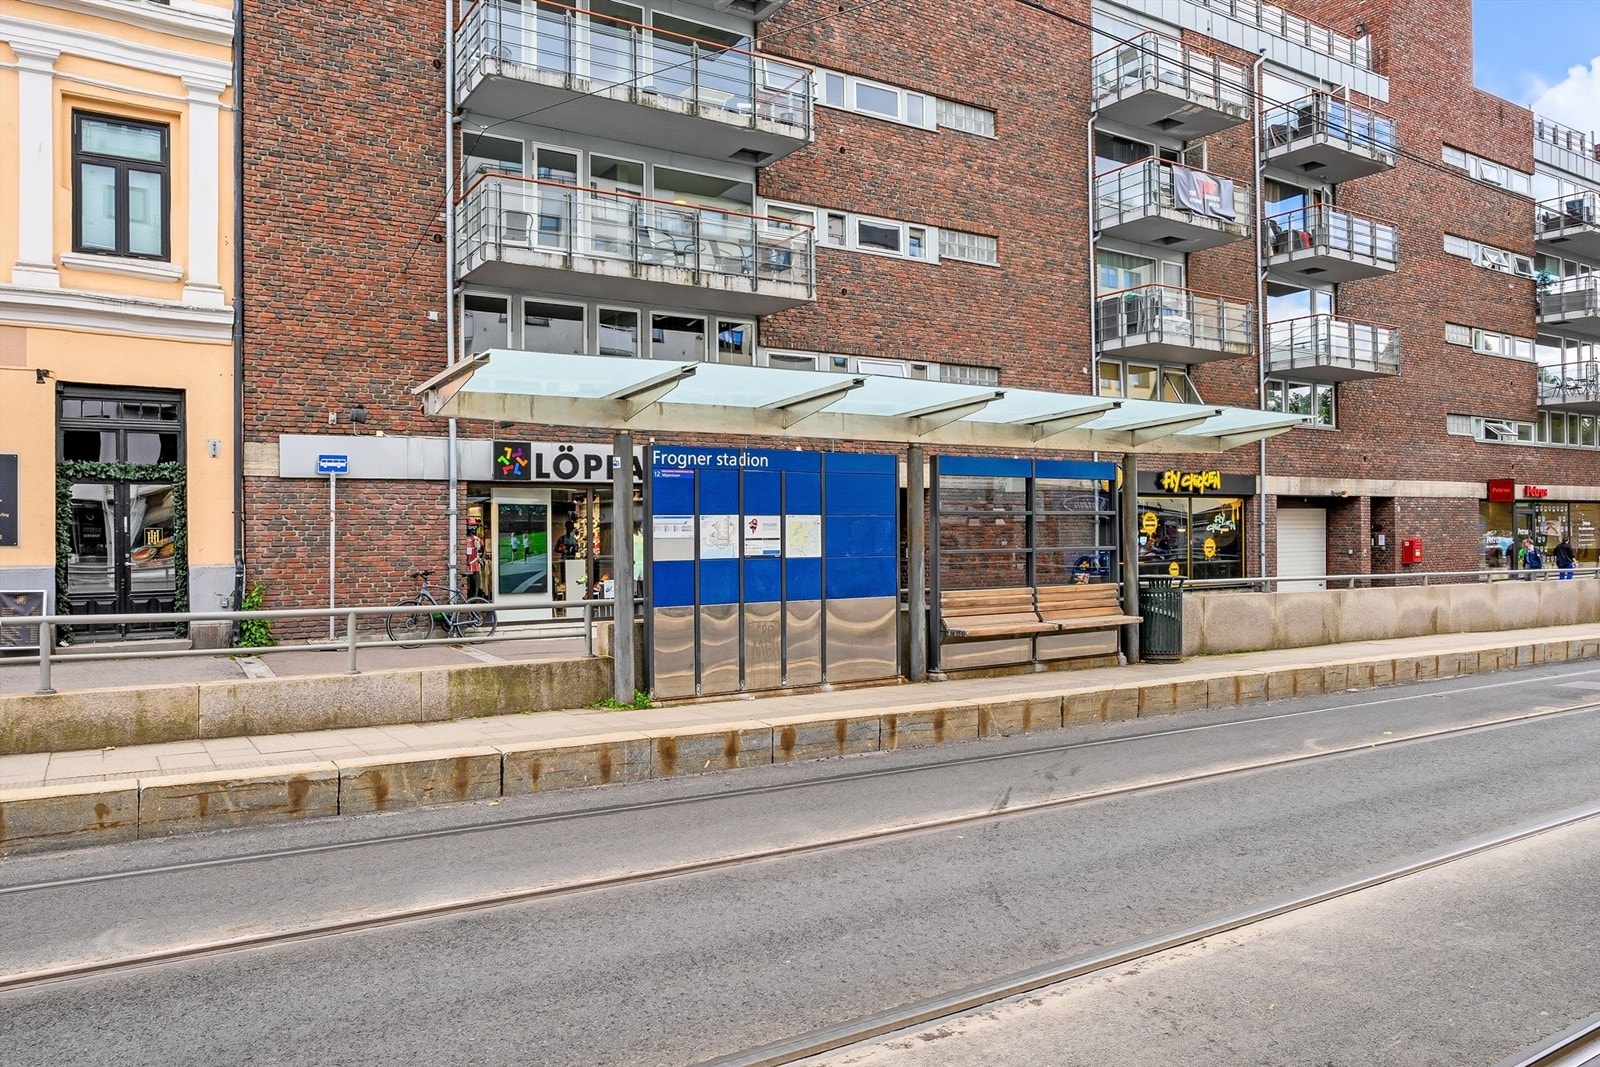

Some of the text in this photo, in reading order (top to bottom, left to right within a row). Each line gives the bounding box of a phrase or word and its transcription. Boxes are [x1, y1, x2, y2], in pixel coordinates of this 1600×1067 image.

[652, 450, 769, 468] Frogner stadion
[1525, 485, 1548, 497] Petrus
